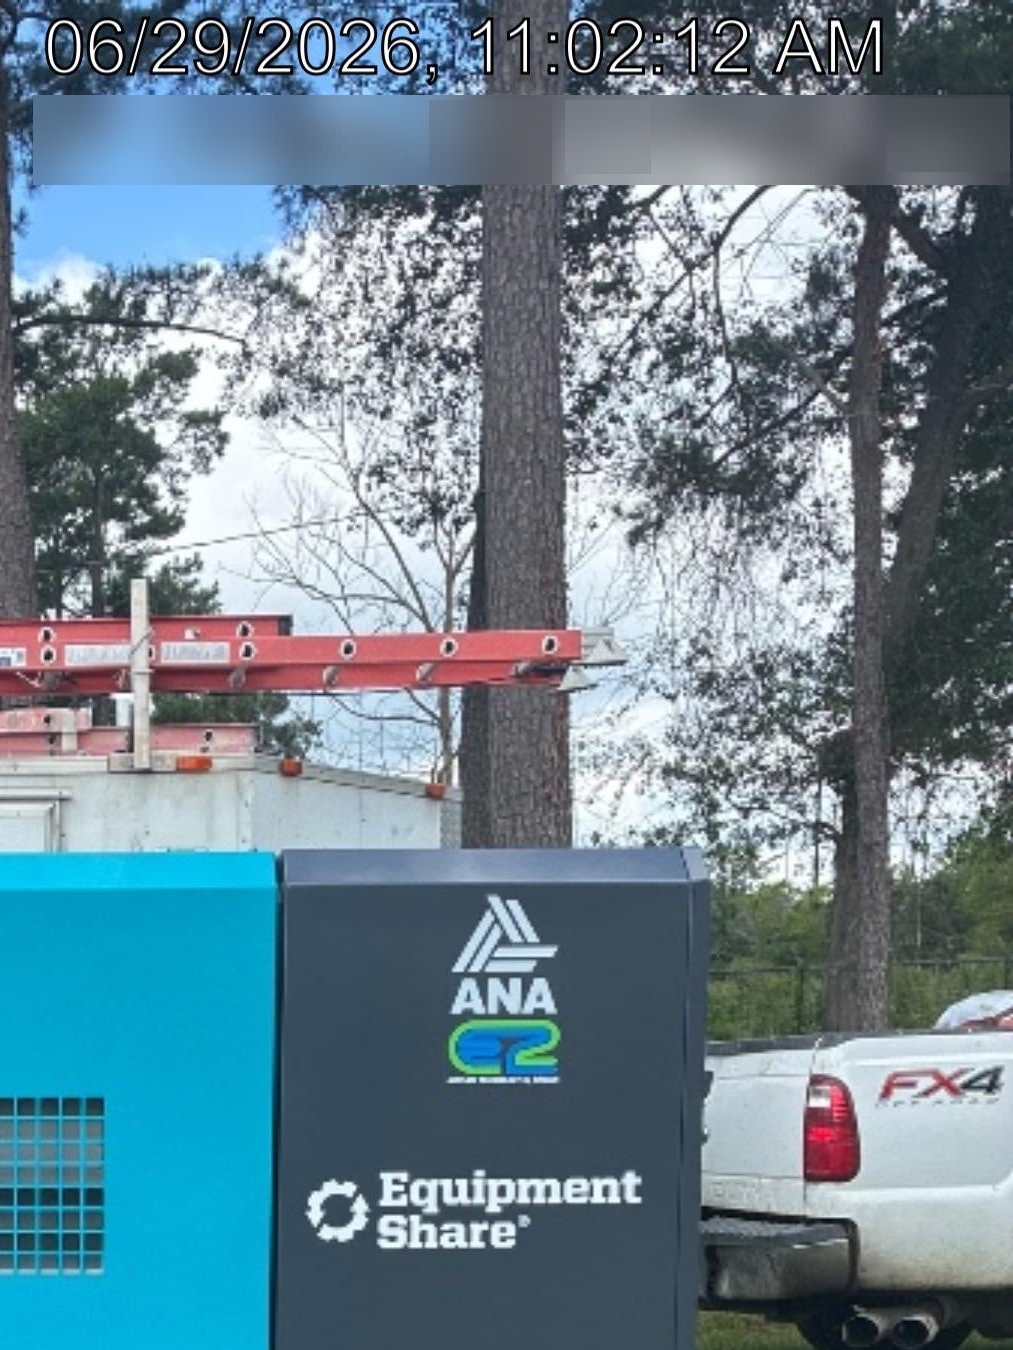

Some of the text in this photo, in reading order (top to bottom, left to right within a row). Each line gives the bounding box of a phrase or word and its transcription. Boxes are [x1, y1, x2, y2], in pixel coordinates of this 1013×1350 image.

[450, 977, 558, 1015] ANA
[877, 1065, 1004, 1100] FX4
[378, 1169, 643, 1214] Equipment
